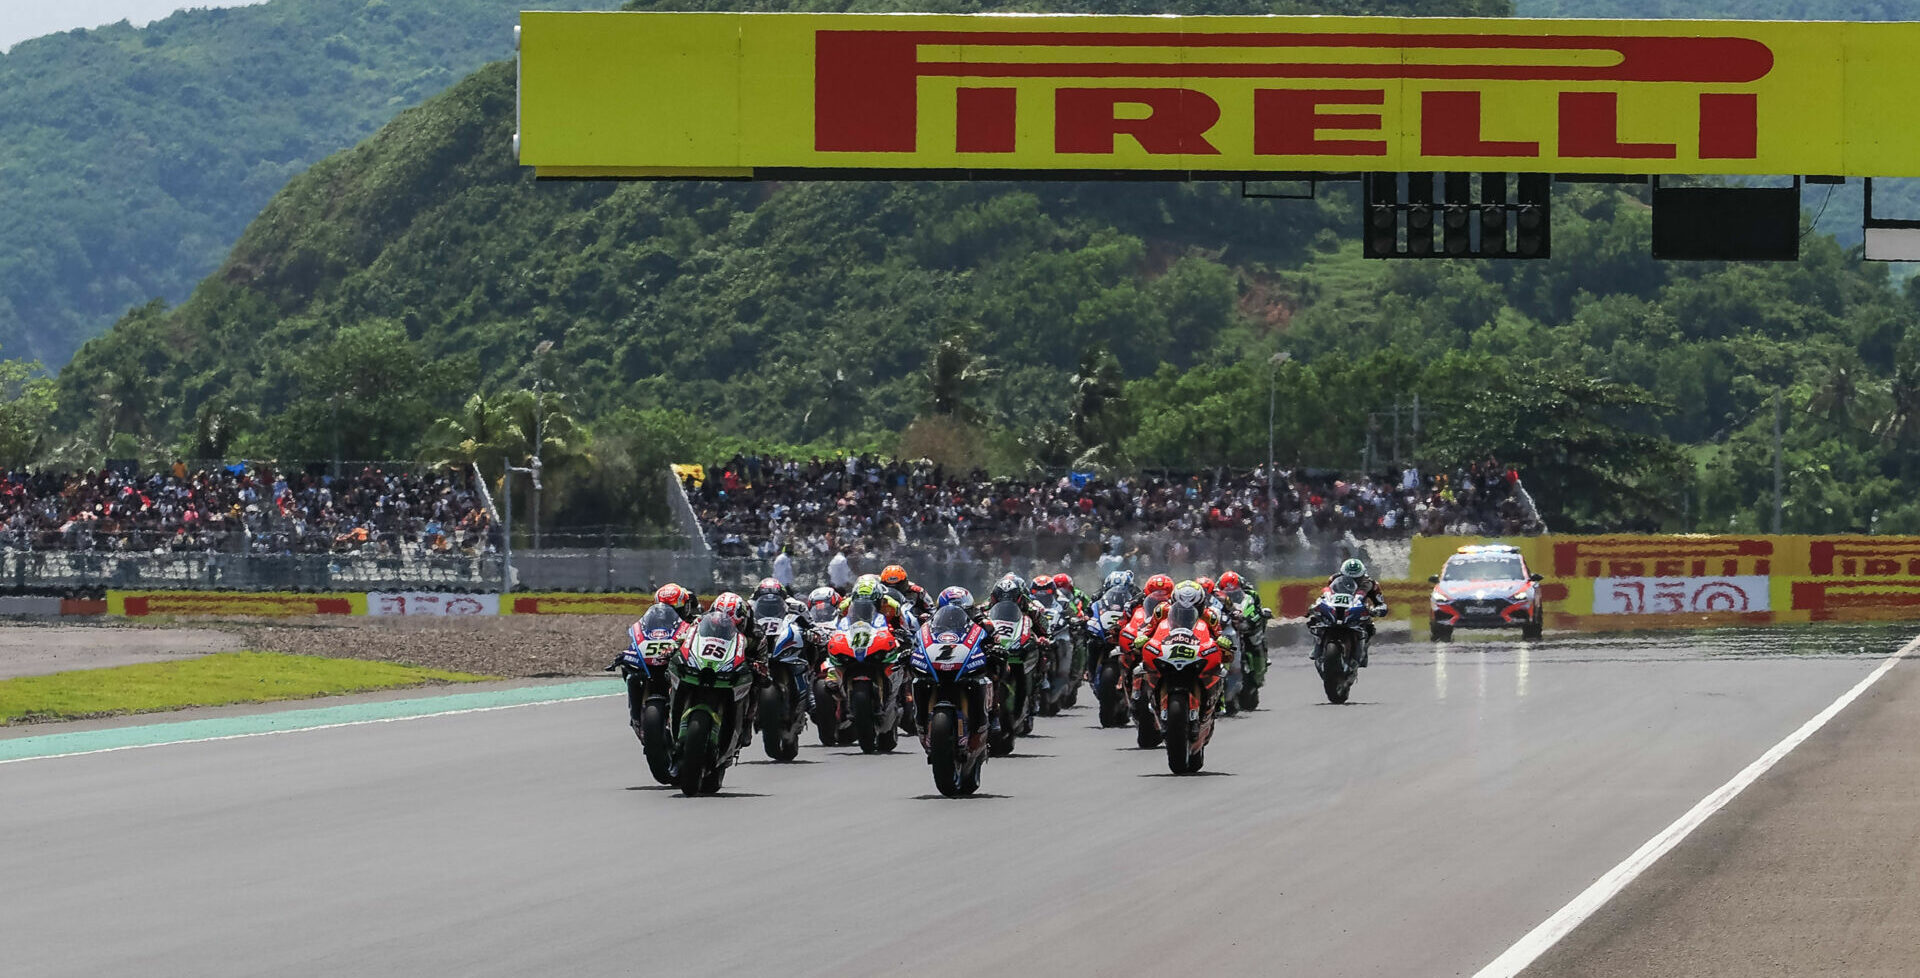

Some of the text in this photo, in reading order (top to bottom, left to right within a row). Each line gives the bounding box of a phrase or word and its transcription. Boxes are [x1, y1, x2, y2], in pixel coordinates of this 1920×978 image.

[815, 30, 1774, 159] PIRELLI
[702, 643, 727, 659] 65
[934, 644, 957, 661] 1
